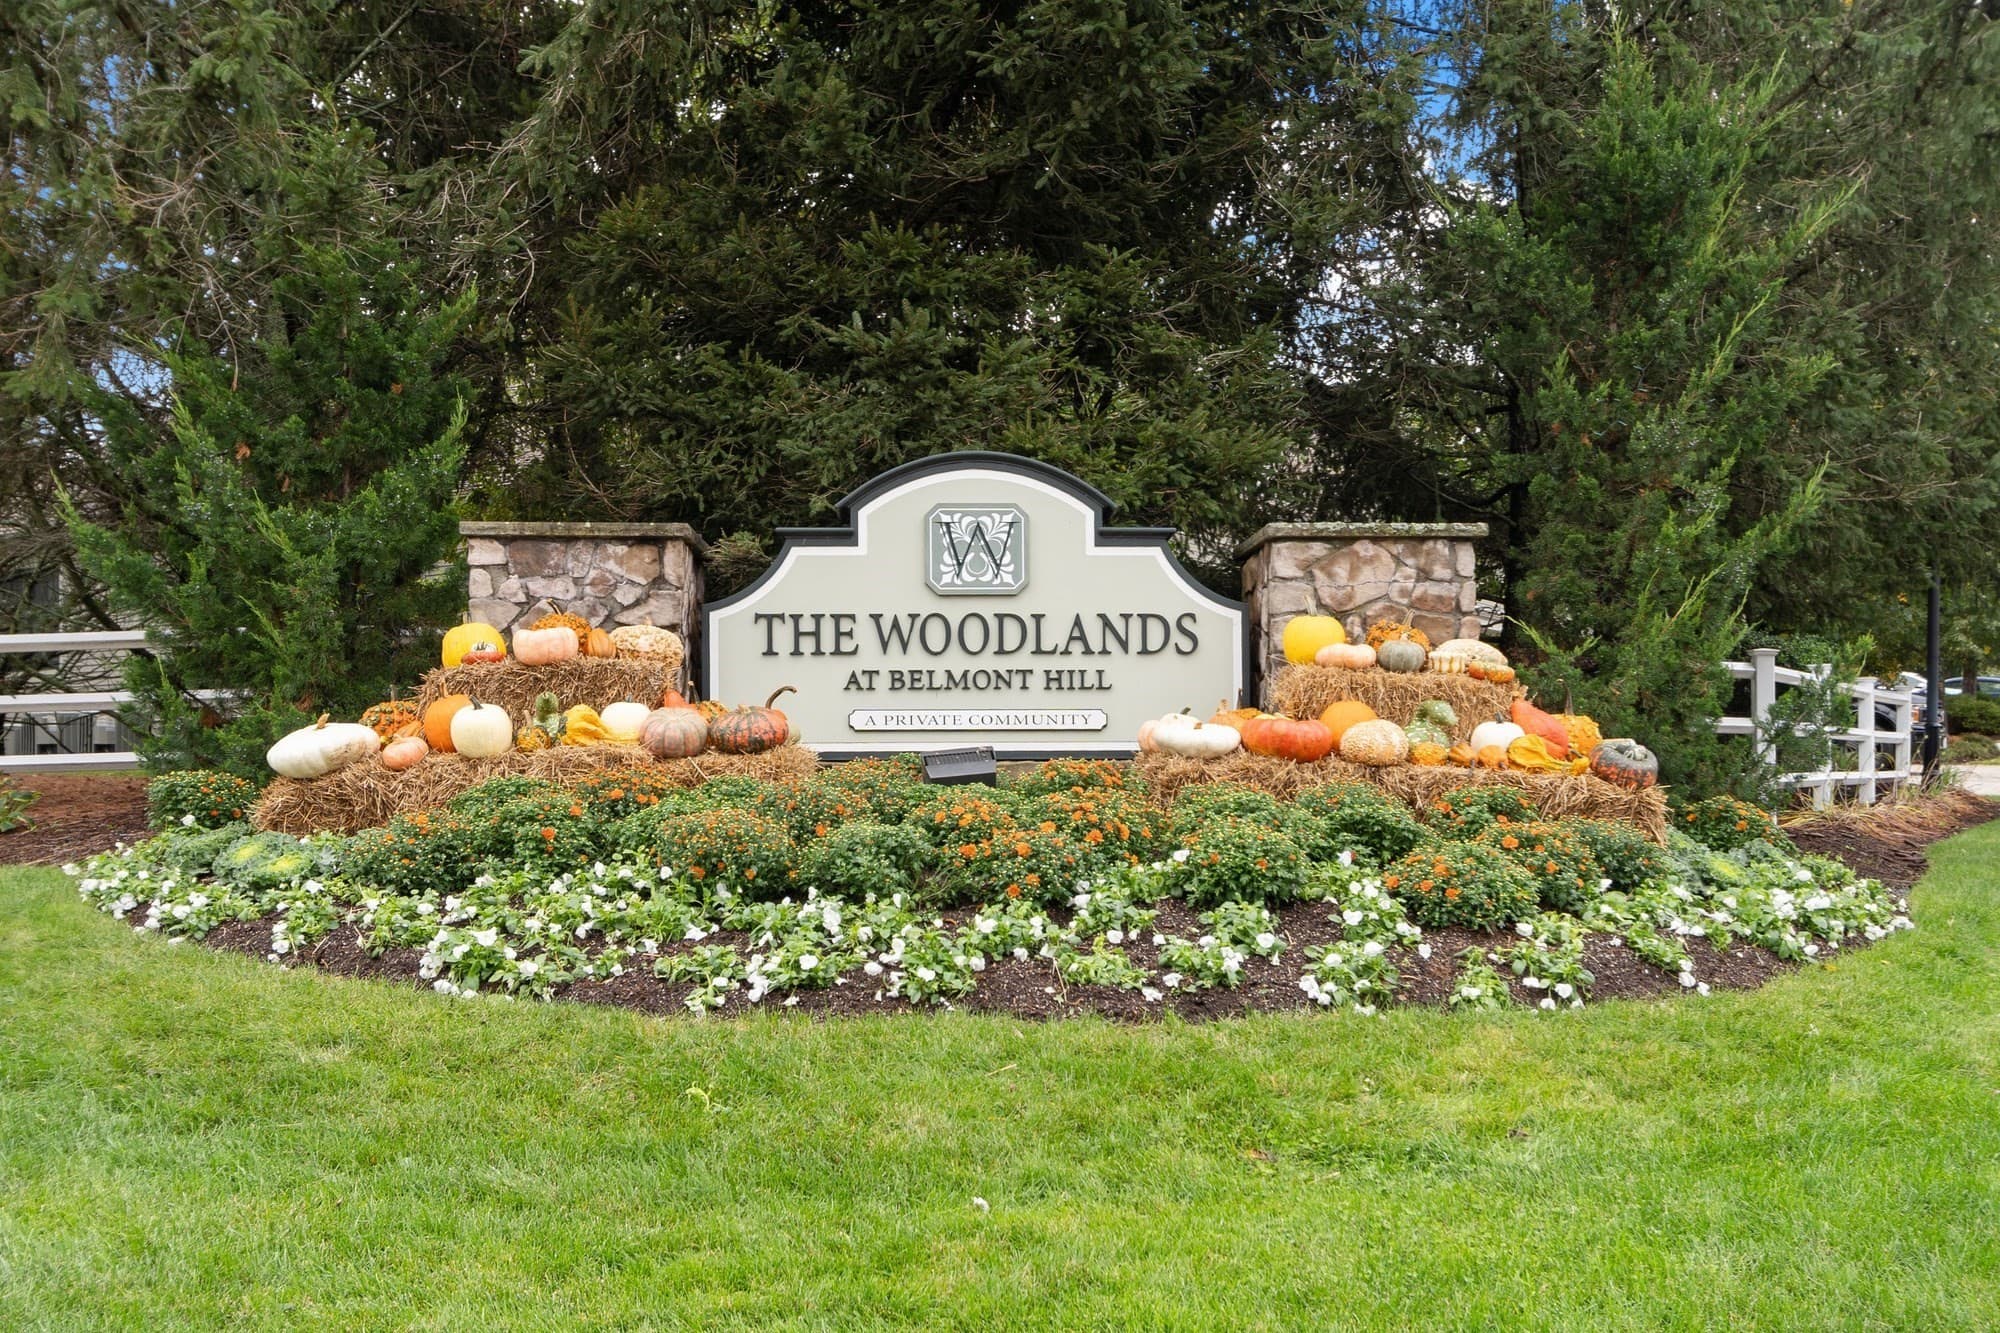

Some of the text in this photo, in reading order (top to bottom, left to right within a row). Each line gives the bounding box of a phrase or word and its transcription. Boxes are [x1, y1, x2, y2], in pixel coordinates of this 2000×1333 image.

[754, 611, 1200, 657] THE WOODLANDS
[843, 669, 1113, 692] AT BELMONT HILL
[864, 713, 1093, 727] A PRIVATE COMMUNITY
